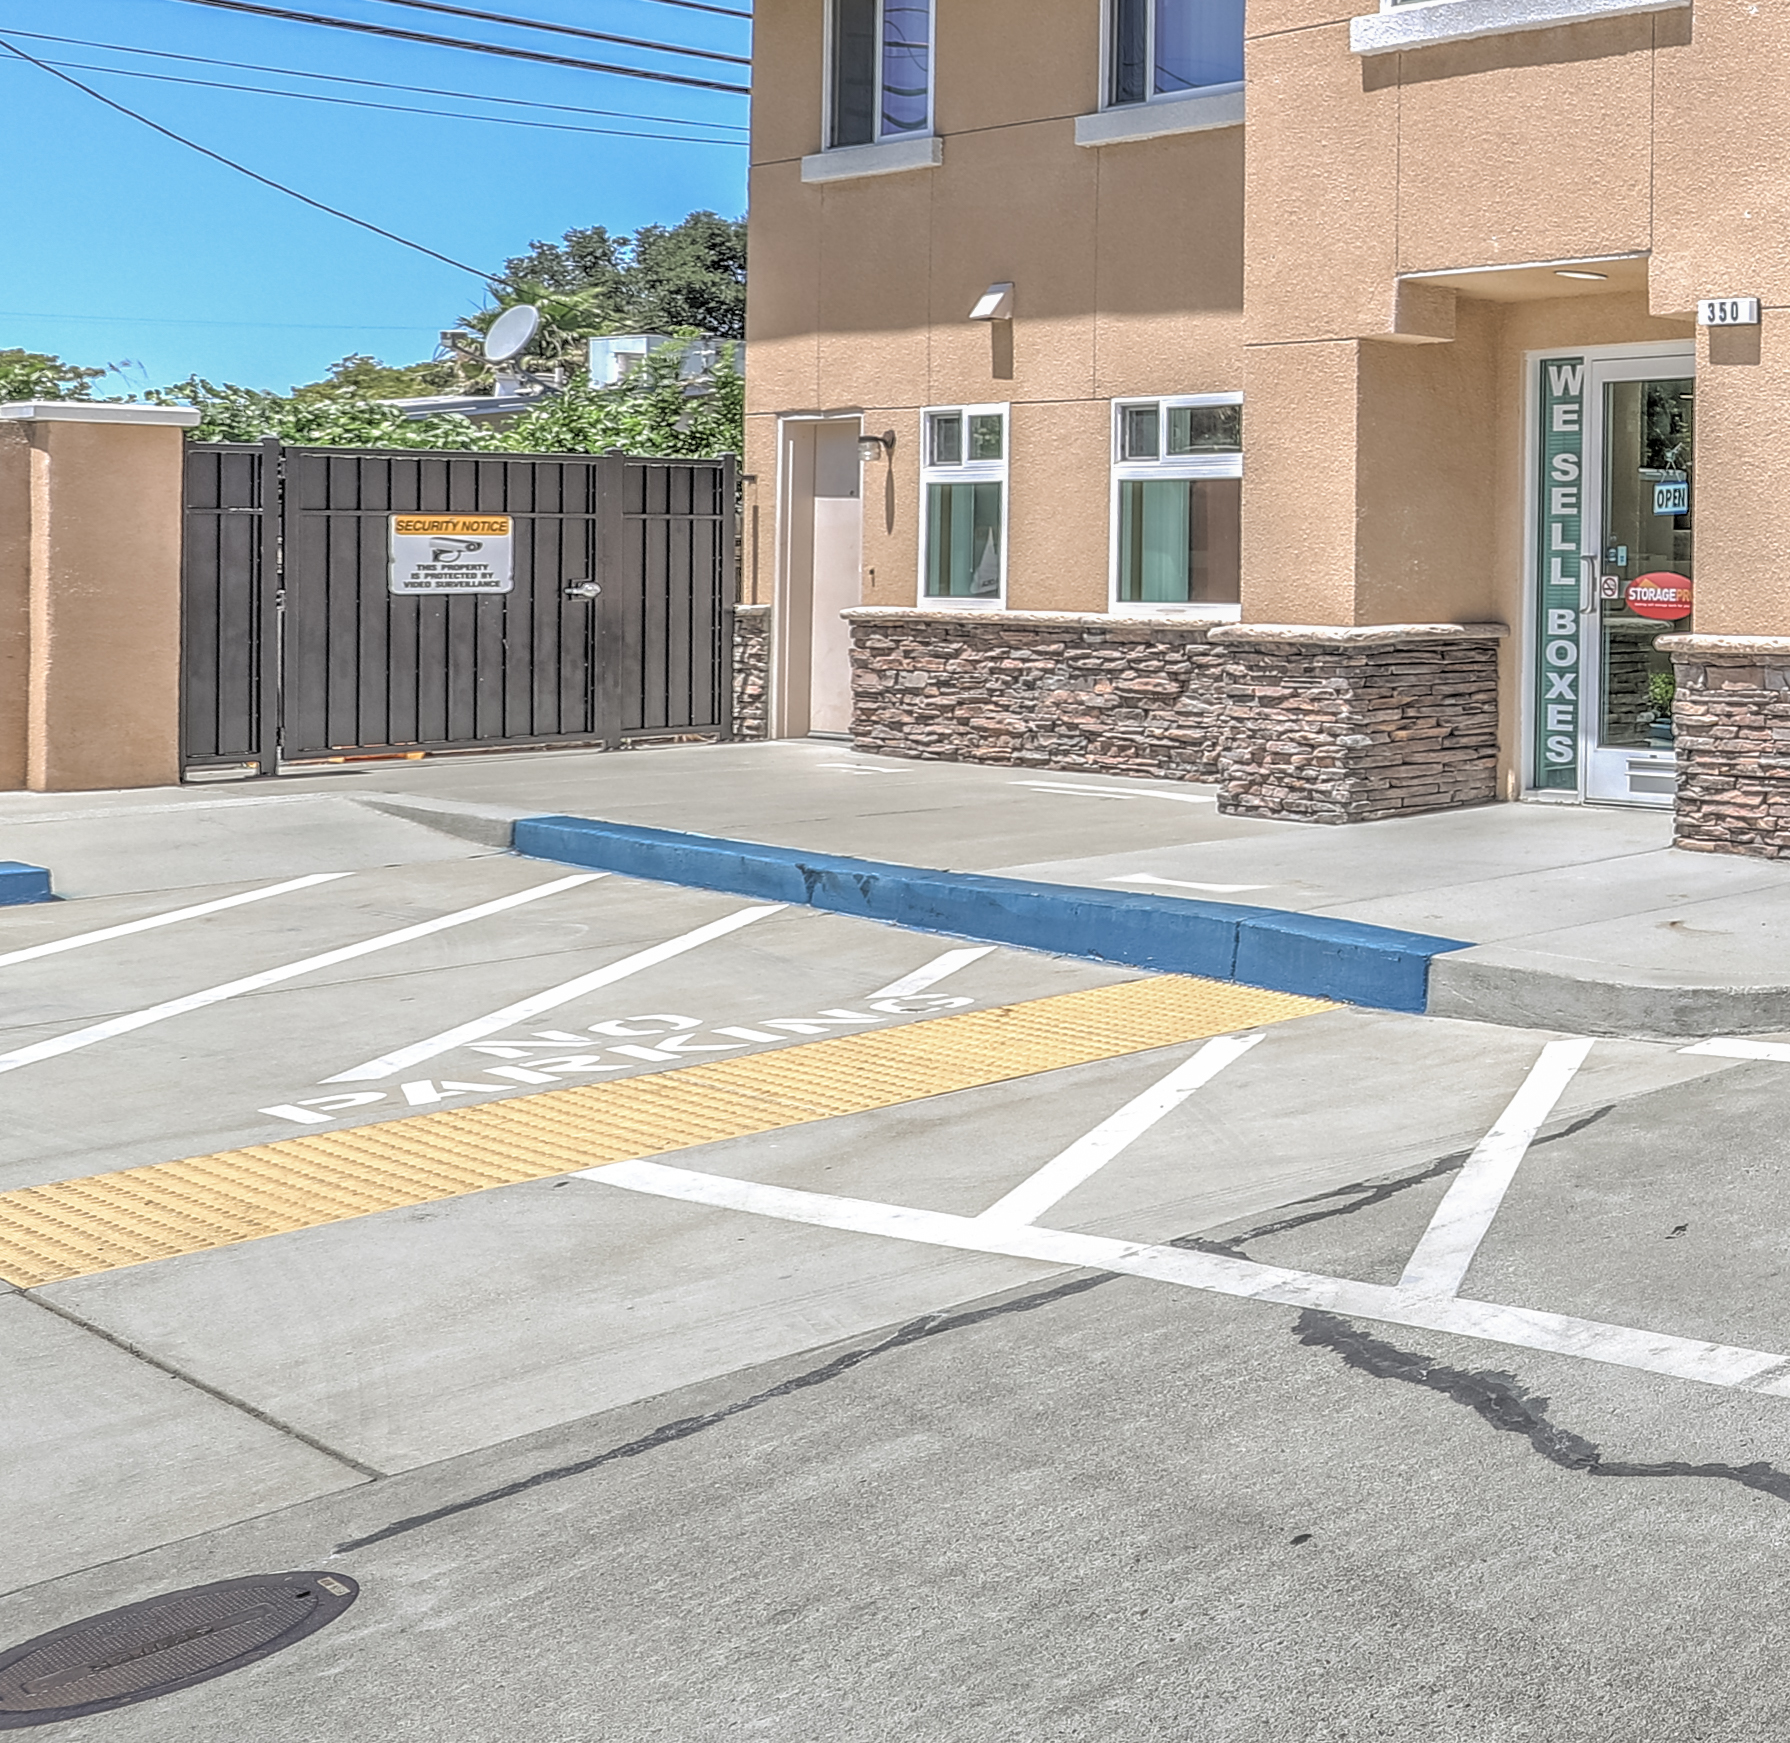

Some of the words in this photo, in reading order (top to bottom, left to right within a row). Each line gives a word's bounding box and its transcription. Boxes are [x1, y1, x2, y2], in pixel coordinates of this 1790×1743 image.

[1707, 301, 1739, 323] 350
[1548, 365, 1584, 432] WE
[396, 520, 460, 532] SECURITY
[461, 520, 508, 532] NOTICE
[1550, 453, 1580, 585] SELL
[1656, 488, 1686, 508] OPEN
[1544, 608, 1578, 763] BOXES
[257, 993, 977, 1126] PARKING
[461, 1013, 704, 1059] NO
